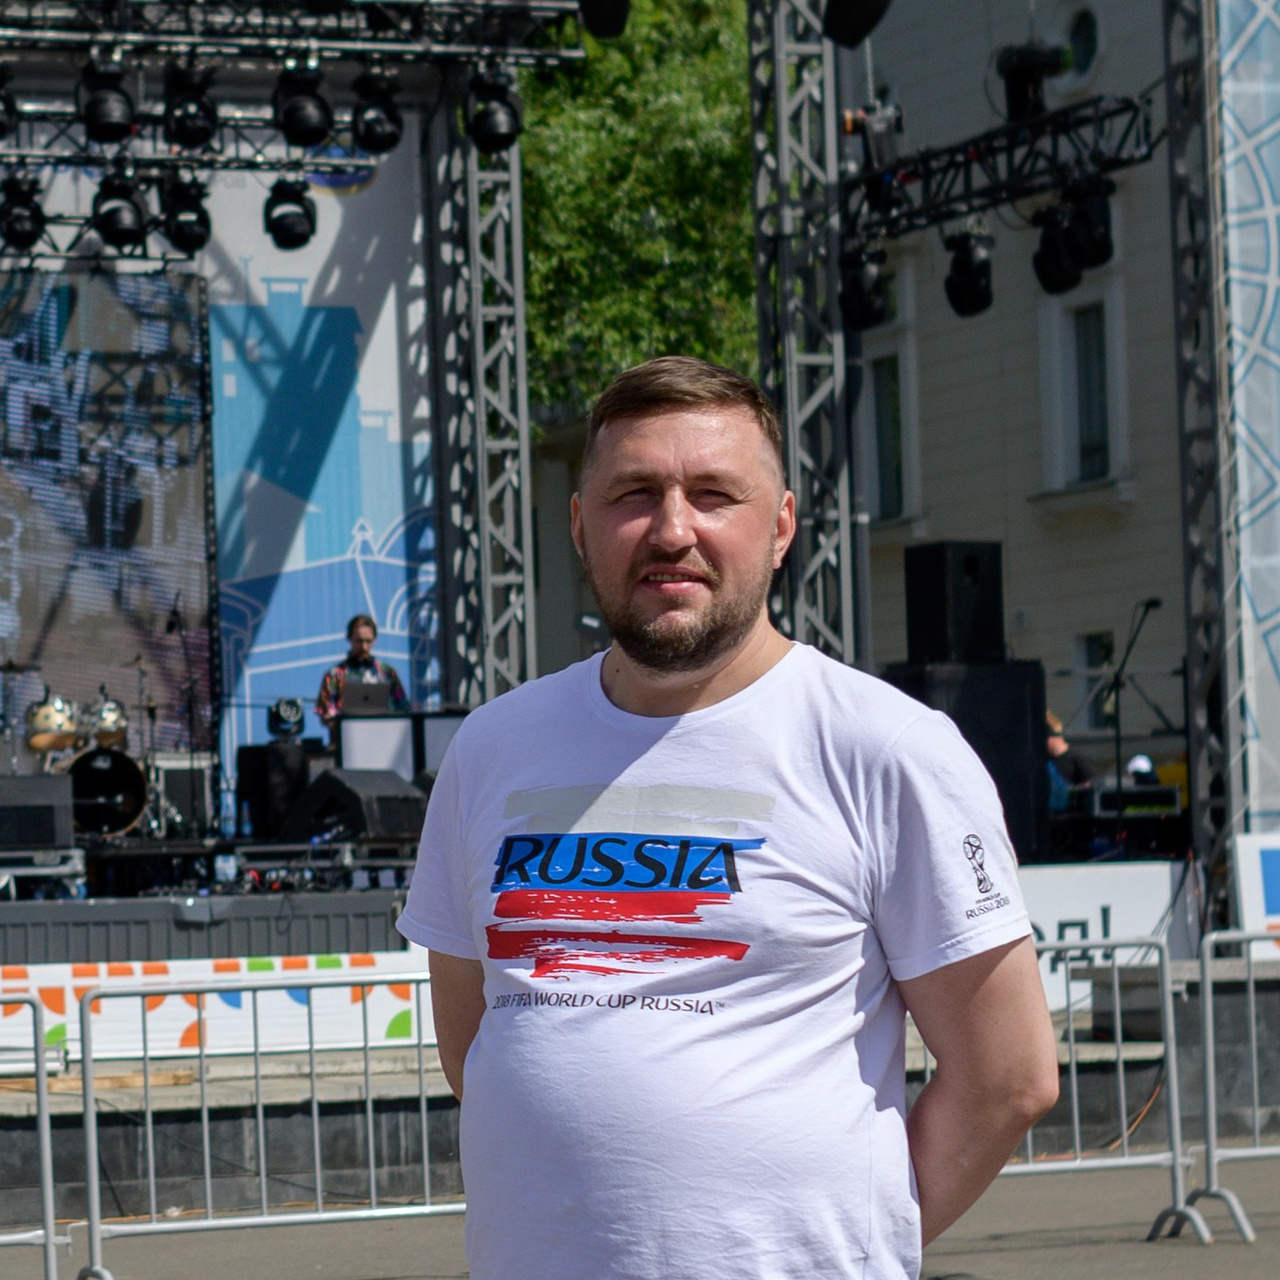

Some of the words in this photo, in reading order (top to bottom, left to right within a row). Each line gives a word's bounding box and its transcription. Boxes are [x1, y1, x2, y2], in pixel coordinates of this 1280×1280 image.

[494, 836, 742, 893] RUSSIA
[534, 992, 595, 1008] WORLD
[596, 993, 637, 1009] CUP
